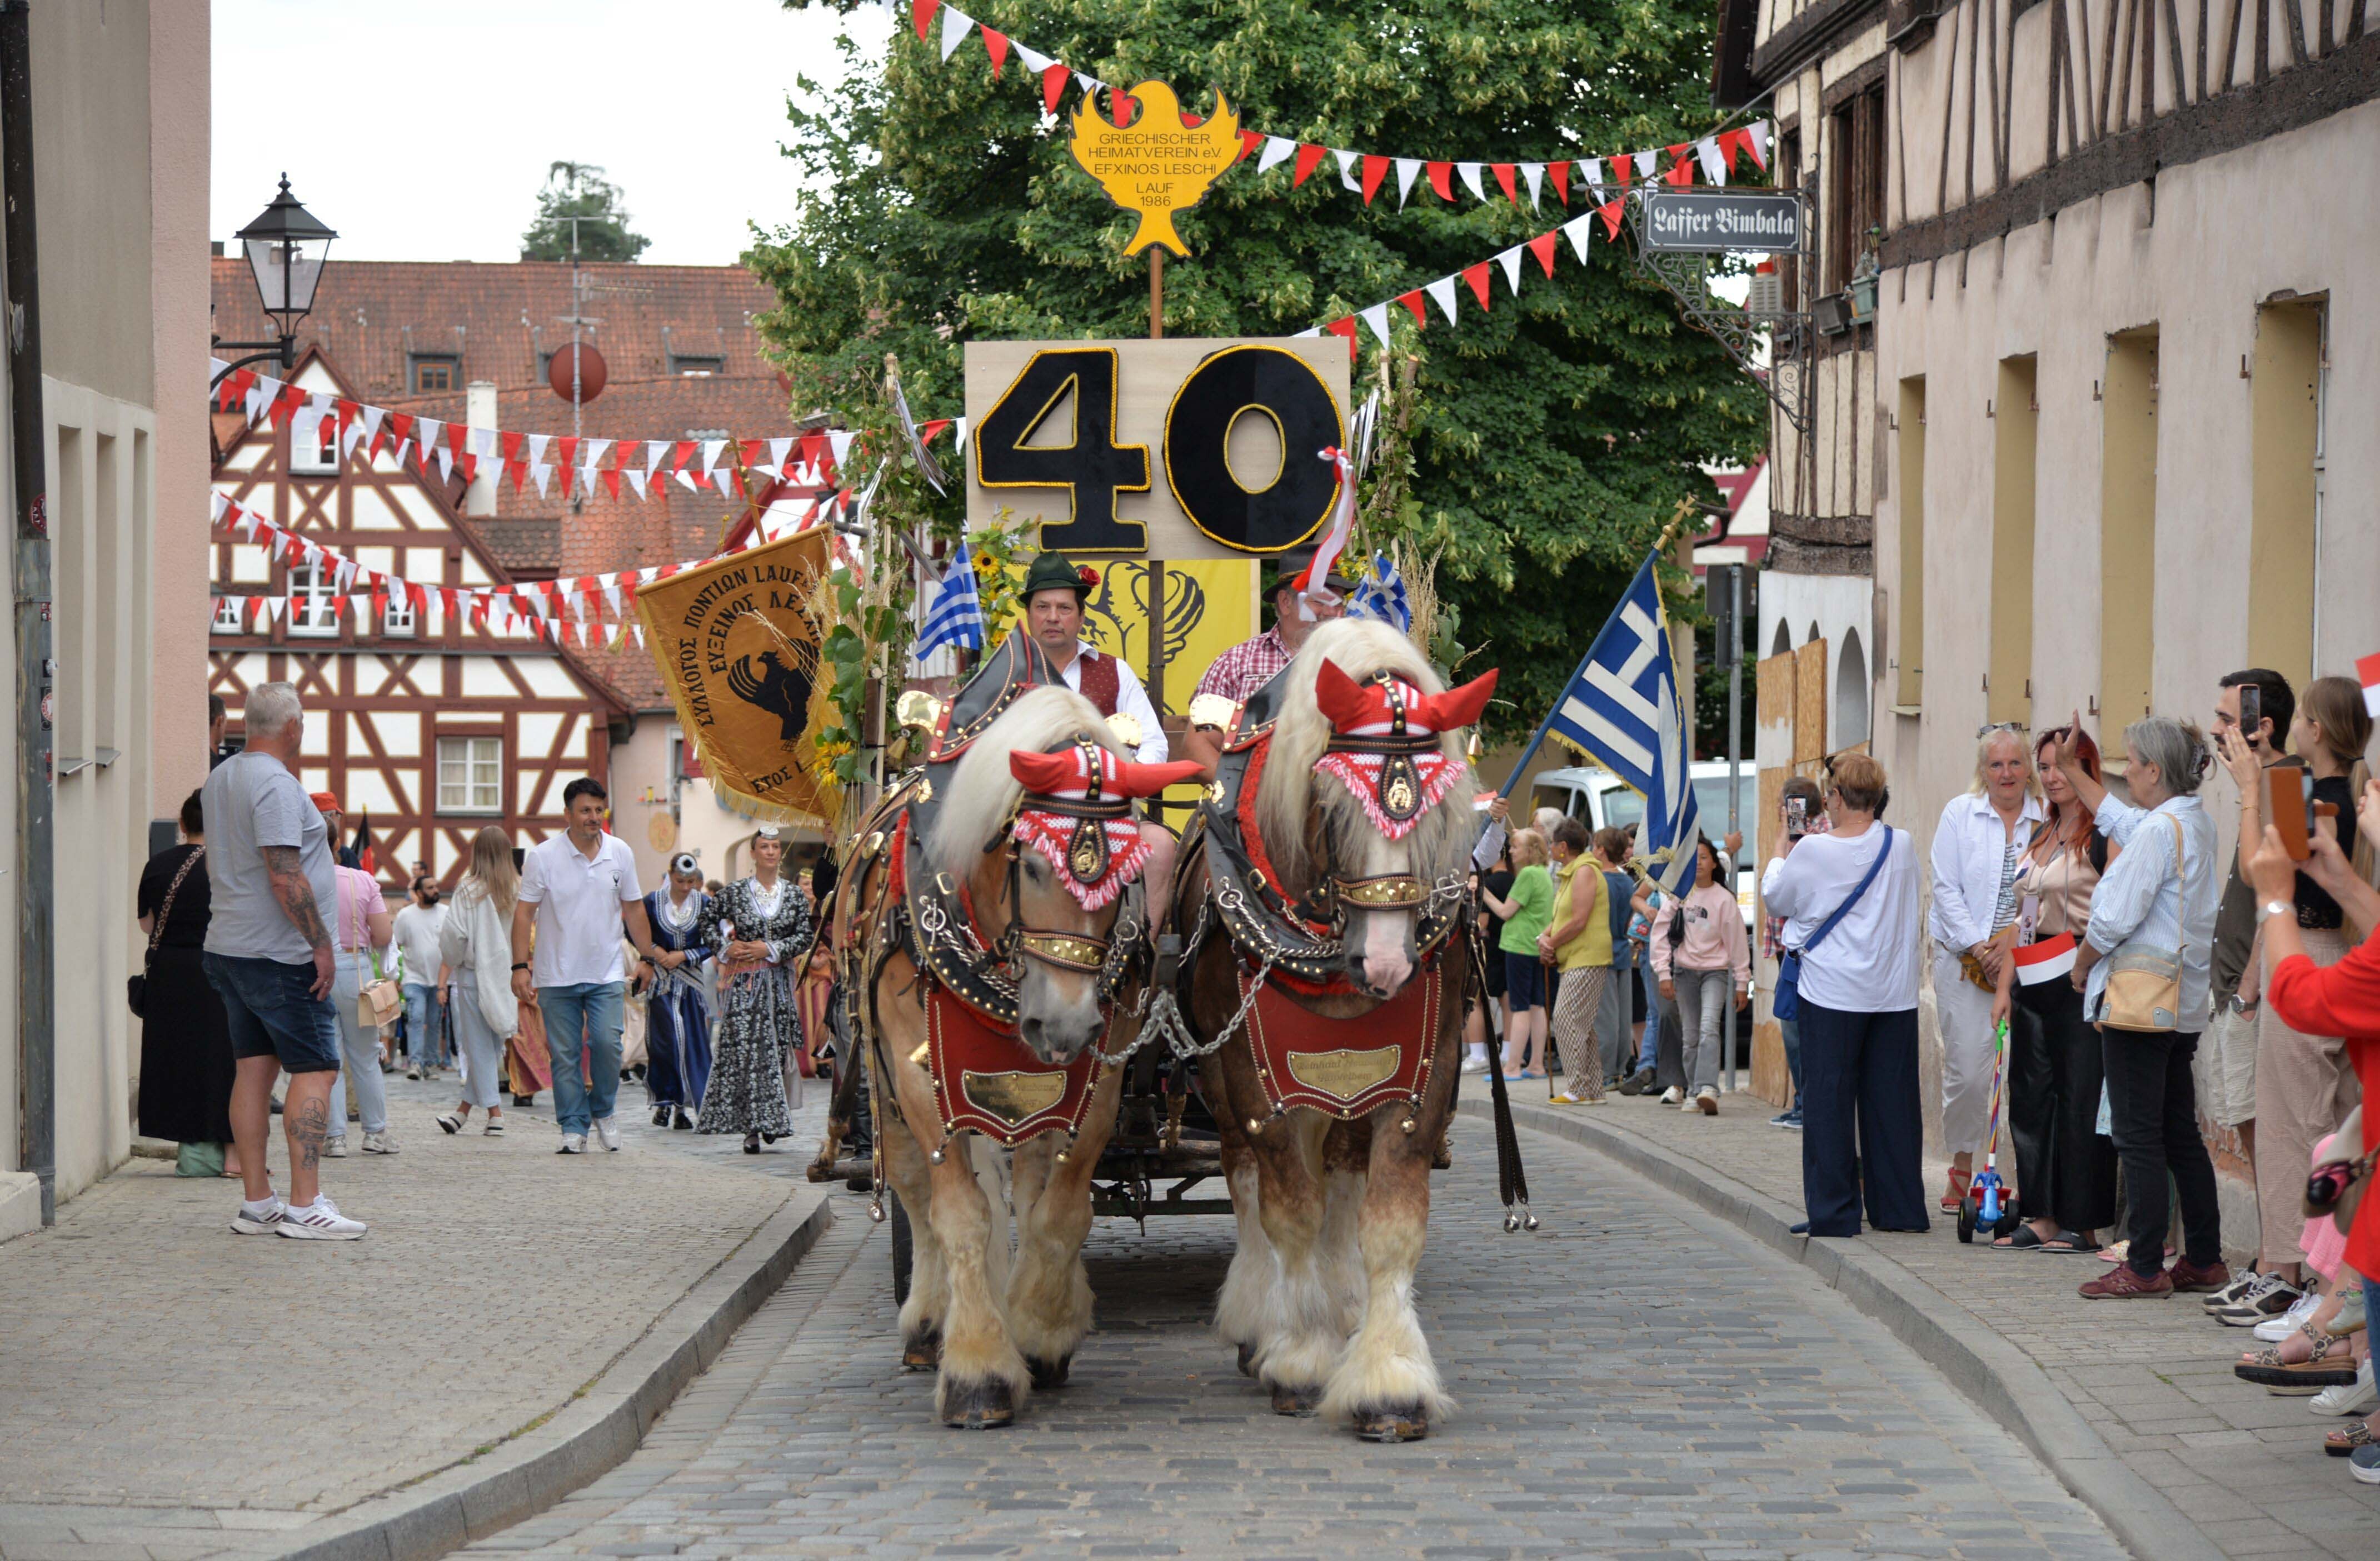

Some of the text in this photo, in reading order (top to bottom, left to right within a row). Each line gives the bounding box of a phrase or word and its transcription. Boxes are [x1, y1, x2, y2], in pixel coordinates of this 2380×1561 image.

[1099, 133, 1210, 144] GRIECHISCHER
[1094, 163, 1216, 175] EFXINOS LESCHI
[1136, 182, 1174, 194] LAUF
[1140, 196, 1171, 207] 1986
[1654, 206, 1795, 239] Laffer Bimbala
[974, 344, 1347, 553] 40
[682, 568, 749, 630] ΠΟΝΤΙΩΝ
[679, 637, 715, 727] ΣΥΛΛΟΓΟΣ
